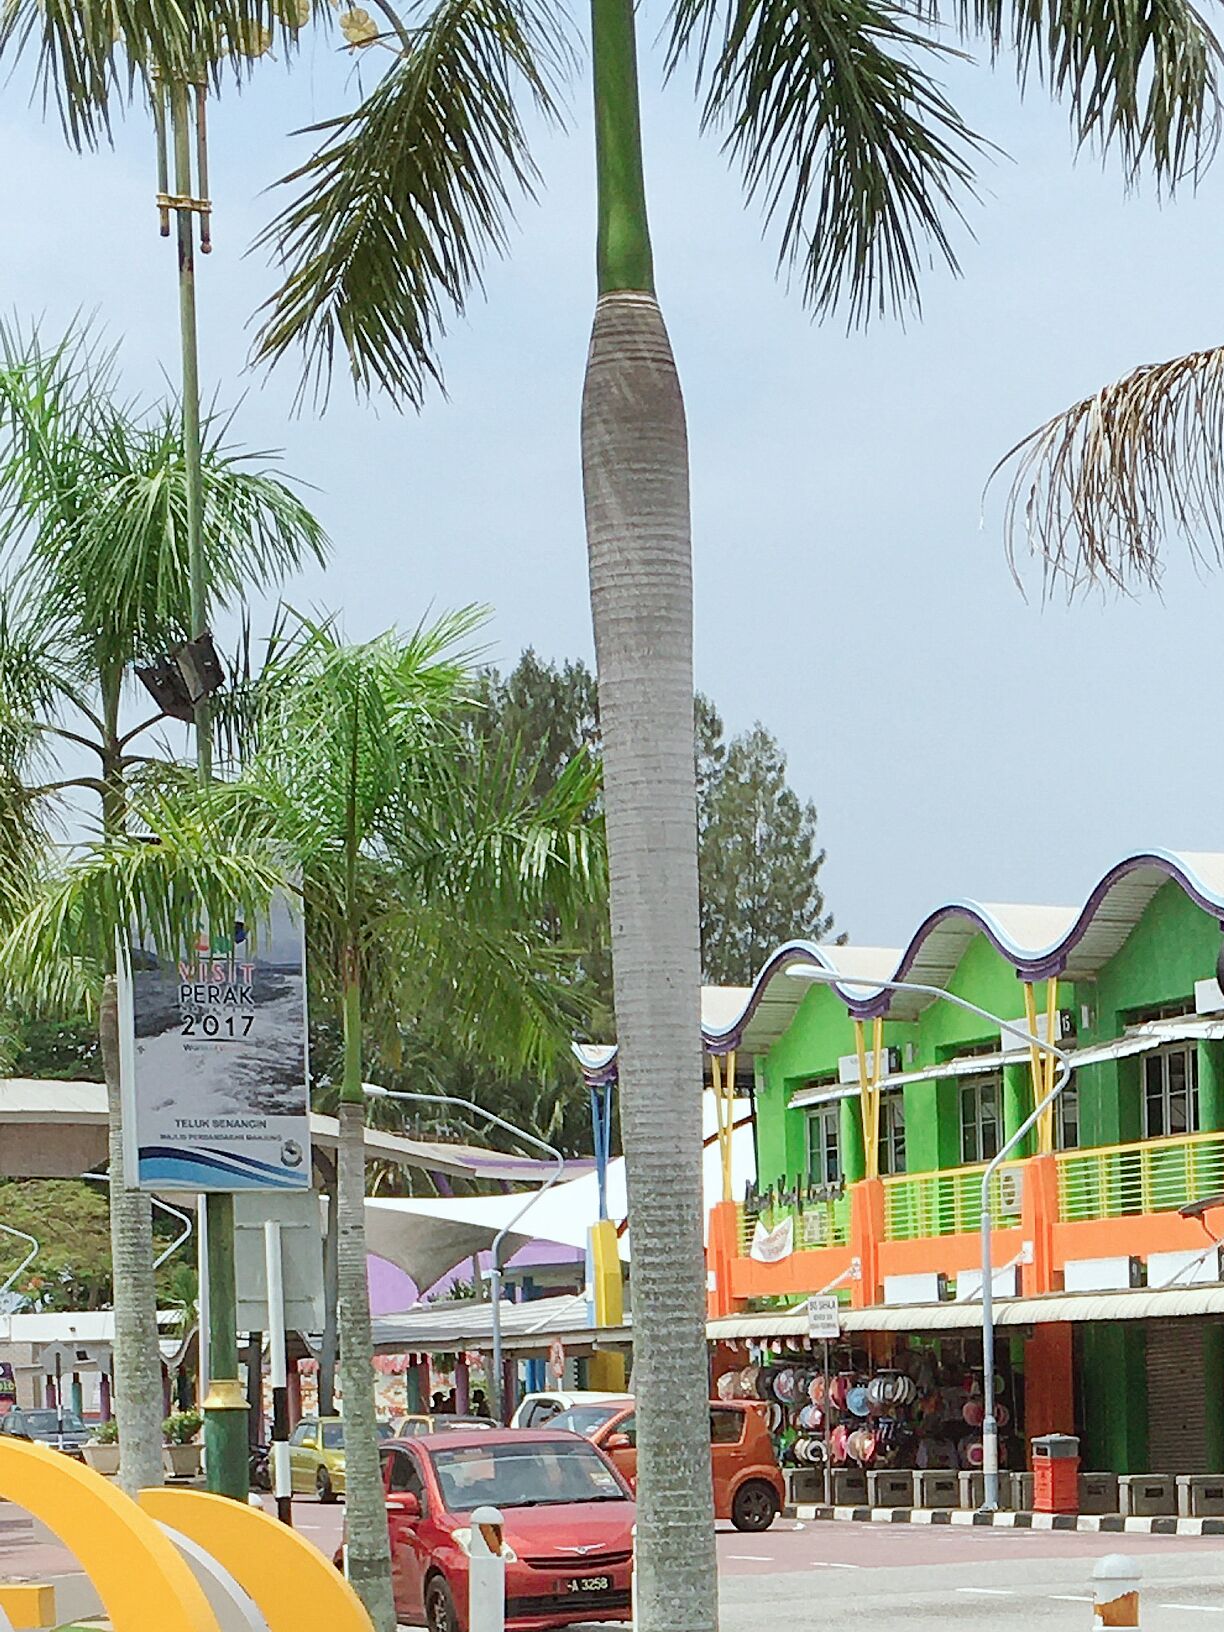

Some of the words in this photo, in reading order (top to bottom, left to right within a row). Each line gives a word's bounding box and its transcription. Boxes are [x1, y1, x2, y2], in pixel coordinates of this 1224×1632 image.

[178, 962, 254, 984] VISIT
[180, 984, 254, 1005] PERAK
[181, 1014, 254, 1036] 2017
[175, 1119, 210, 1128] TELUK
[212, 1119, 267, 1129] SENANGIN
